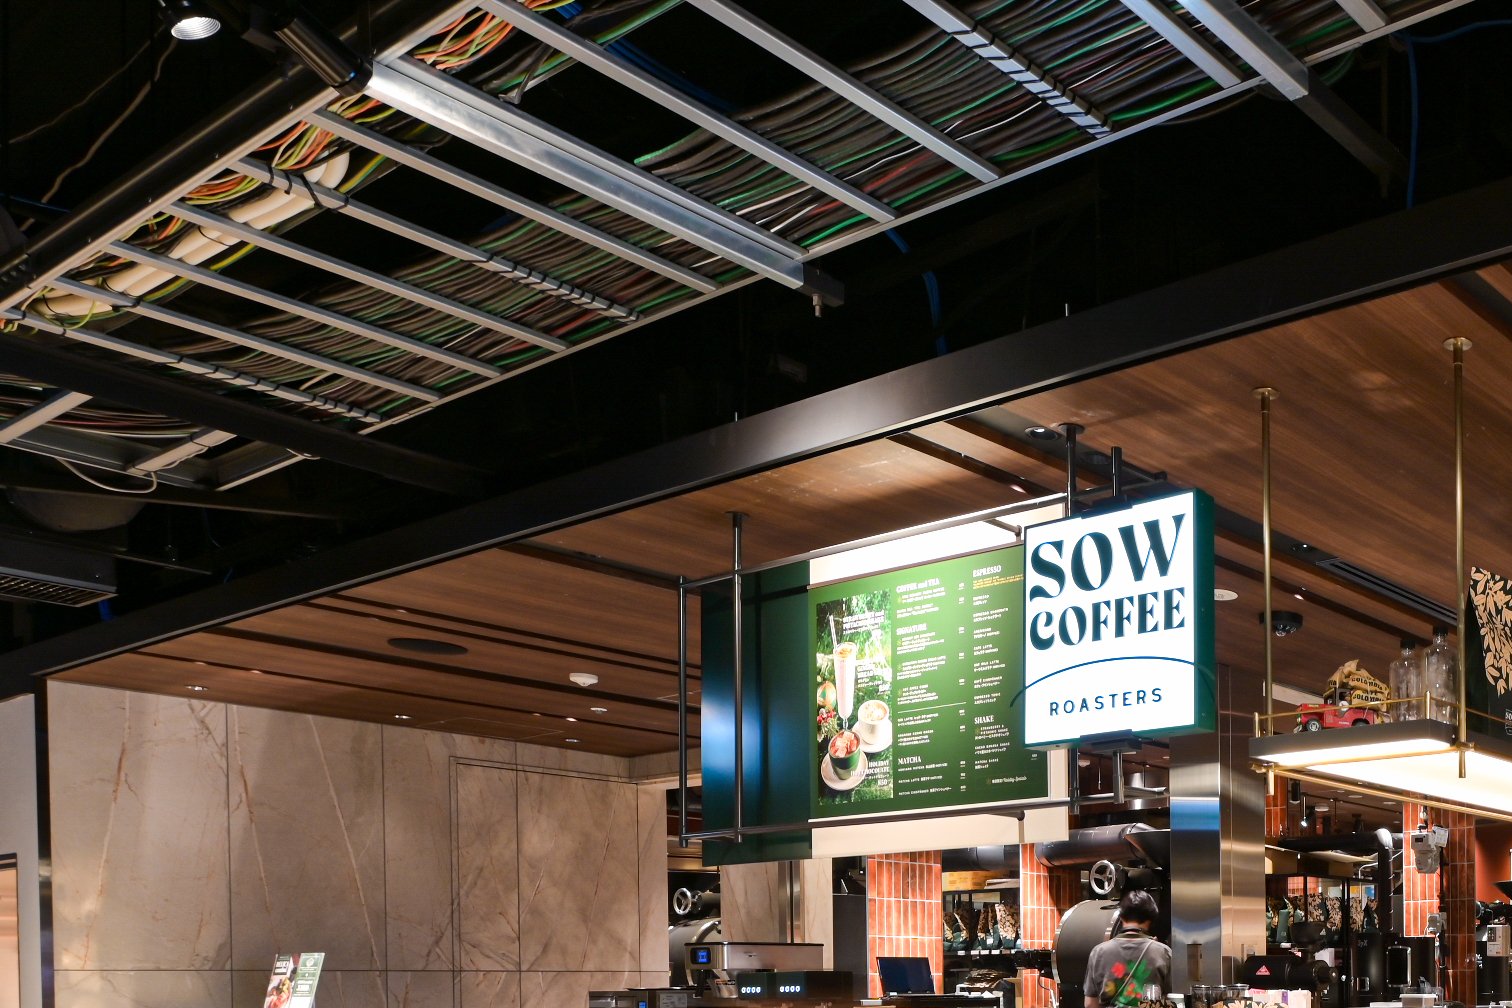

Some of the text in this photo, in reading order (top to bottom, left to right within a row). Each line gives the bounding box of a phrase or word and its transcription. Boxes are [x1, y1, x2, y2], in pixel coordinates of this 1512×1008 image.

[1029, 513, 1186, 602] SOW
[972, 565, 1002, 578] ESPRESSO
[1030, 587, 1185, 651] COFFEE
[1049, 687, 1163, 716] ROASTERS
[974, 715, 995, 725] SHAKE
[898, 755, 922, 765] MATCHA
